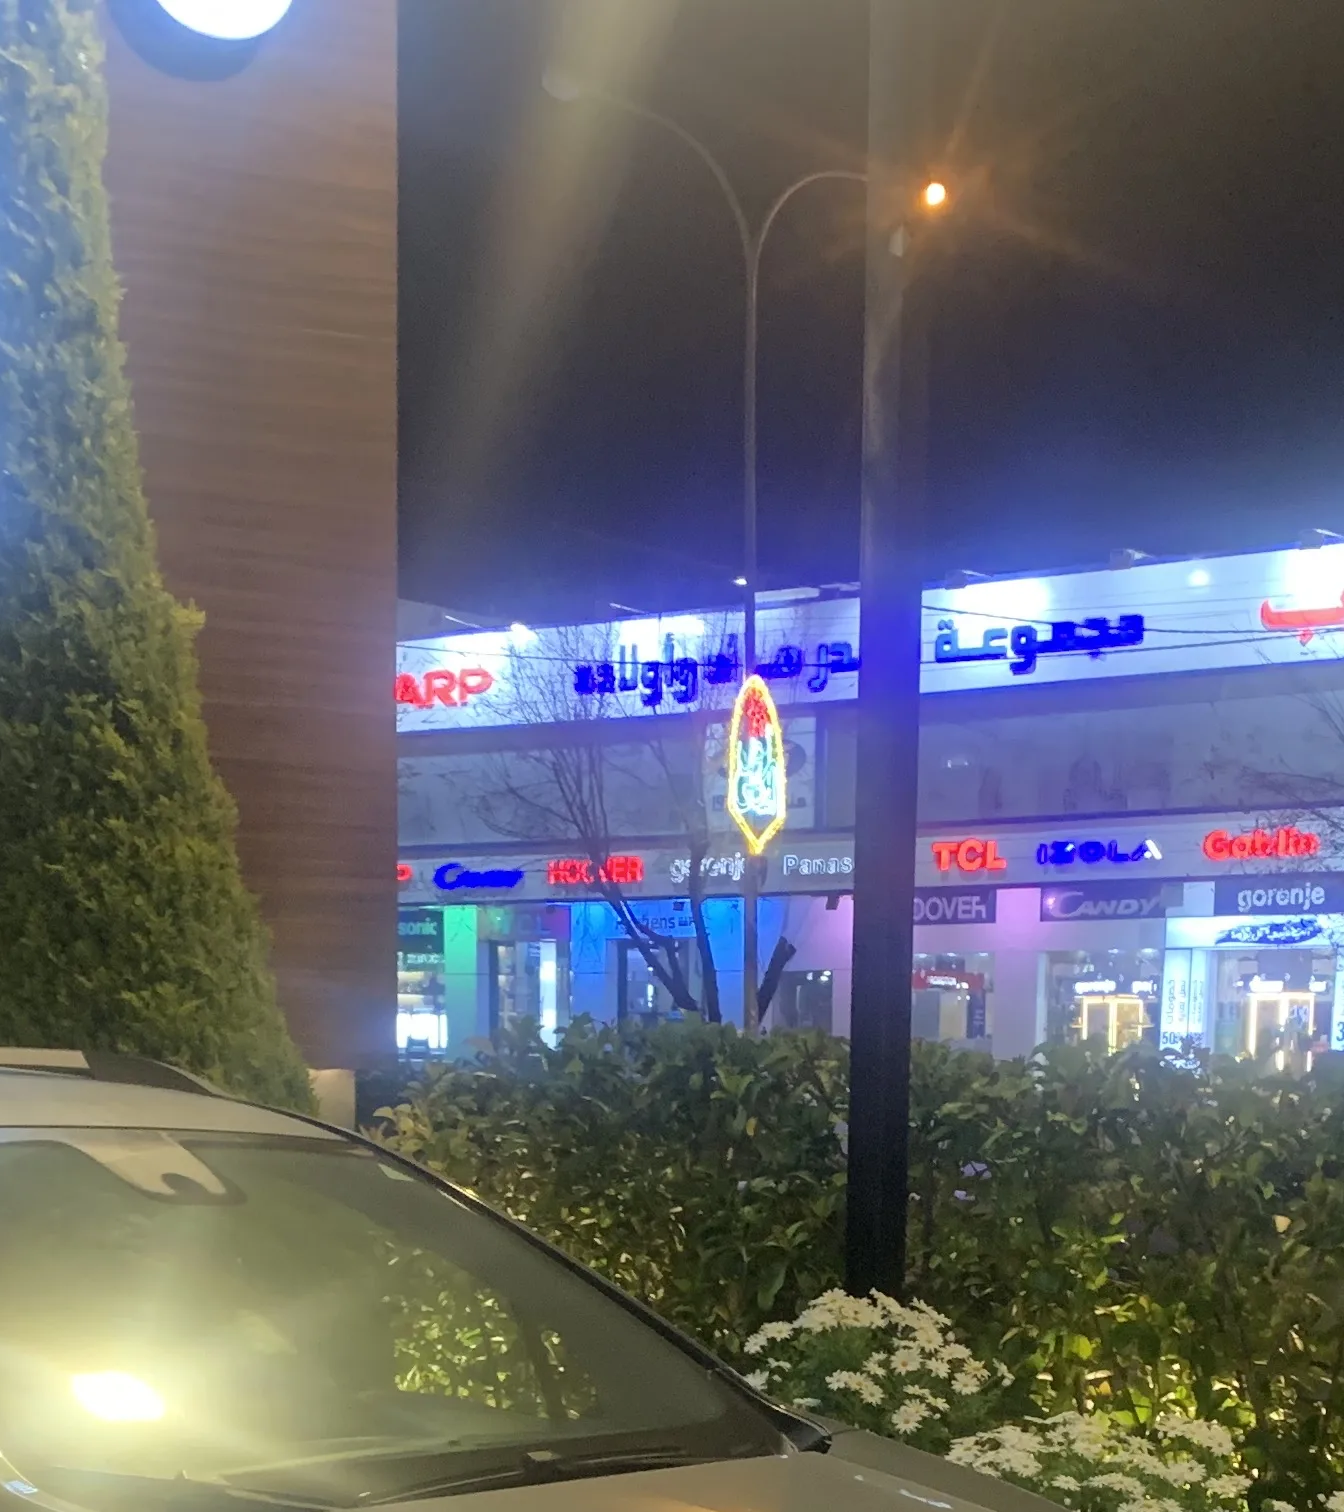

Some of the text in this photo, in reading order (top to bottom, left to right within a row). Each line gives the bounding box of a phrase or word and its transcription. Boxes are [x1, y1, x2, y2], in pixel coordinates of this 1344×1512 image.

[394, 667, 493, 709] ARP
[783, 854, 853, 876] Panas
[932, 838, 1006, 871] TCL
[1237, 882, 1326, 912] gorenje
